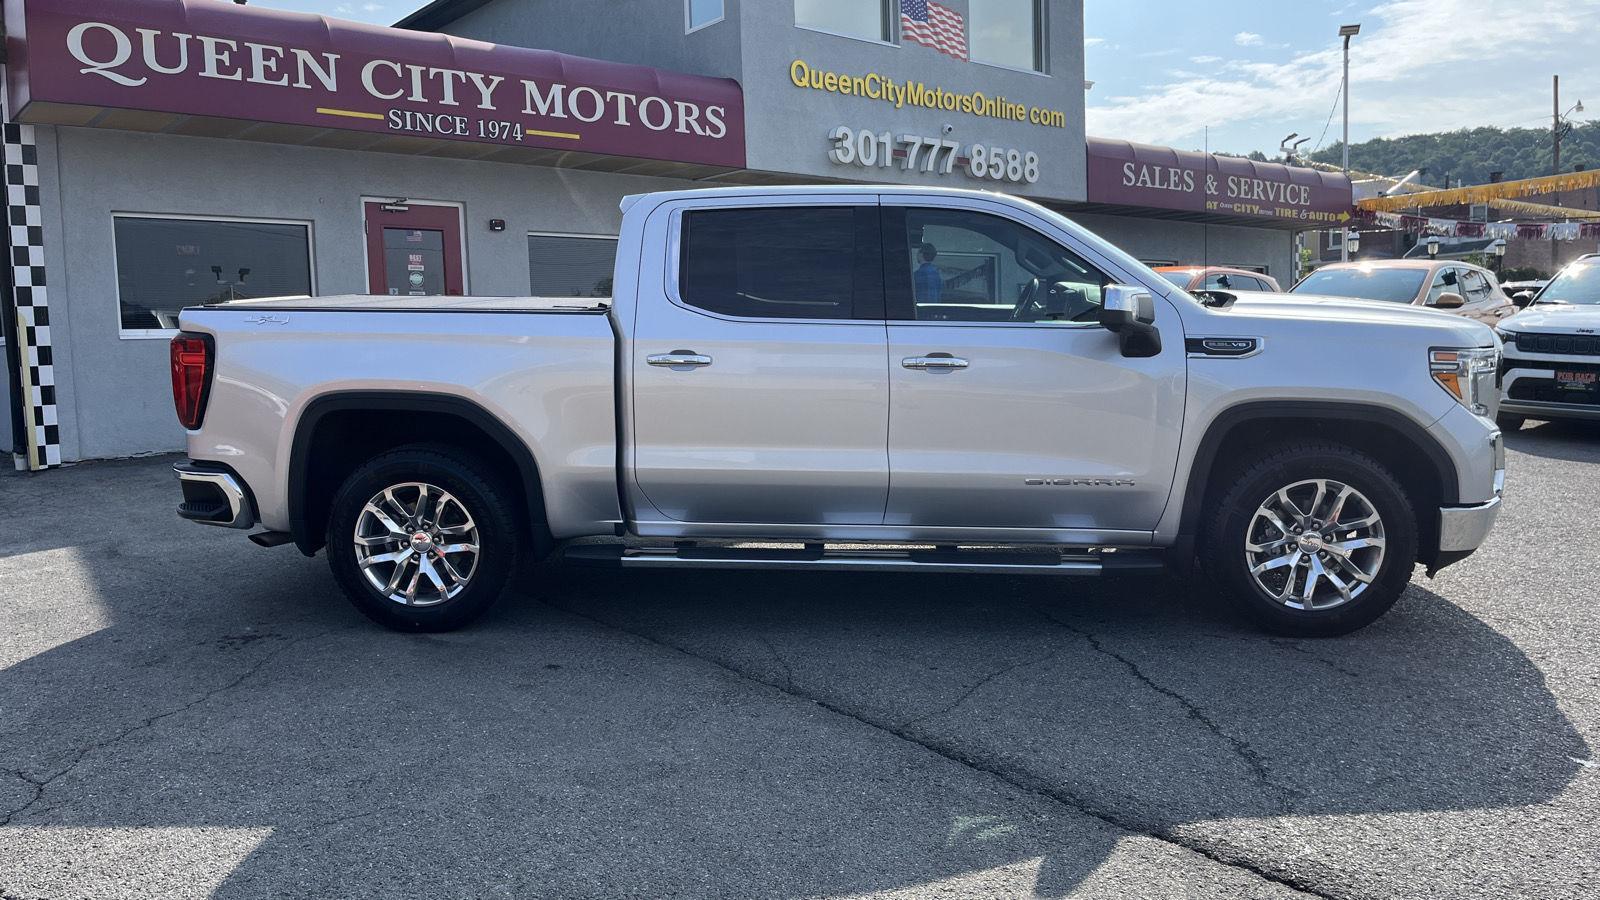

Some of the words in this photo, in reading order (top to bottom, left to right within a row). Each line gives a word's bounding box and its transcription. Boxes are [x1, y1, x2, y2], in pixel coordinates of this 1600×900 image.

[66, 21, 341, 92] QUEEN
[361, 59, 505, 110] CITY
[519, 79, 727, 139] MOTORS
[388, 109, 470, 136] SINCE
[477, 119, 524, 142] 1974
[1122, 162, 1195, 193] SALES
[1205, 173, 1219, 196] &
[1227, 175, 1311, 206] SERVICE
[1206, 200, 1218, 210] AT
[1233, 203, 1260, 215] CITY
[1274, 207, 1299, 219] TIRE
[1300, 209, 1309, 220] &
[1308, 211, 1336, 222] AUTO
